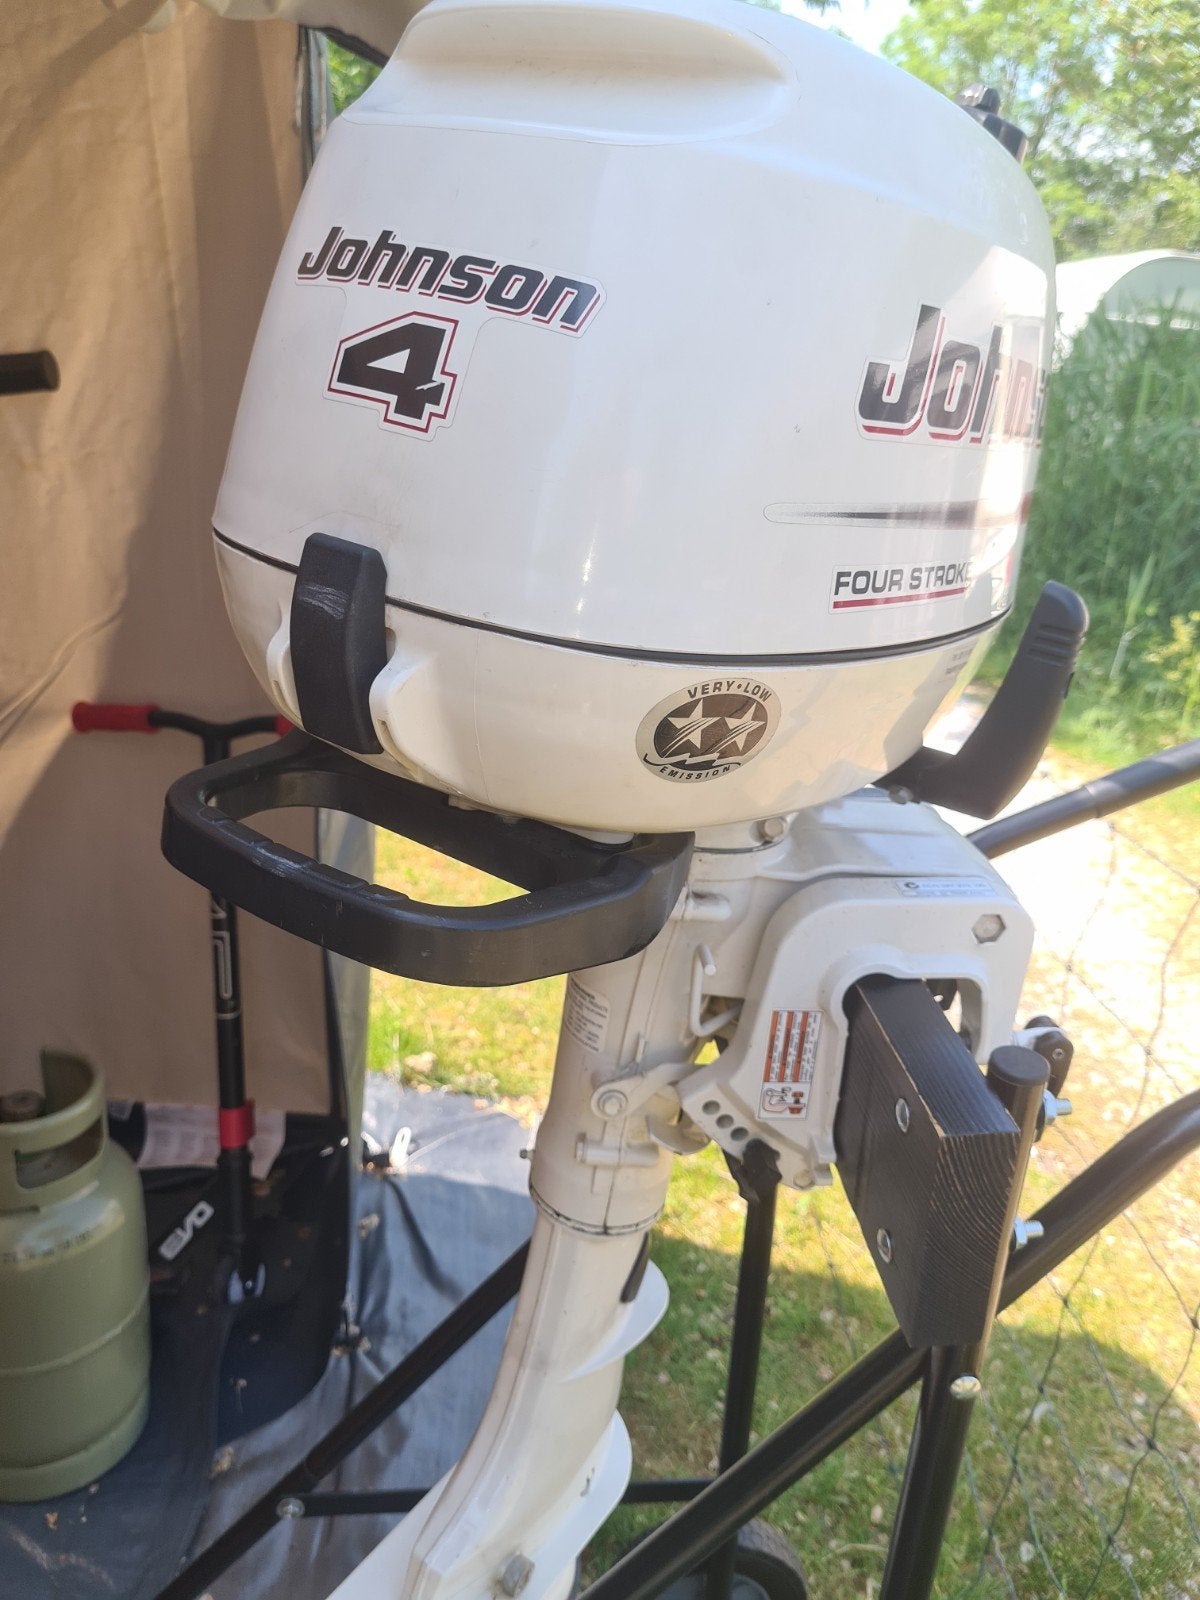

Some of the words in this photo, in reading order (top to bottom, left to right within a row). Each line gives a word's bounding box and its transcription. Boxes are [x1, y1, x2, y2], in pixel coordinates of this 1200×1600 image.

[297, 226, 601, 333] Johnson
[331, 316, 454, 428] 4
[833, 568, 904, 596] FOUR
[687, 680, 736, 699] VERY
[743, 682, 772, 702] LOW
[659, 765, 731, 780] EMISSION
